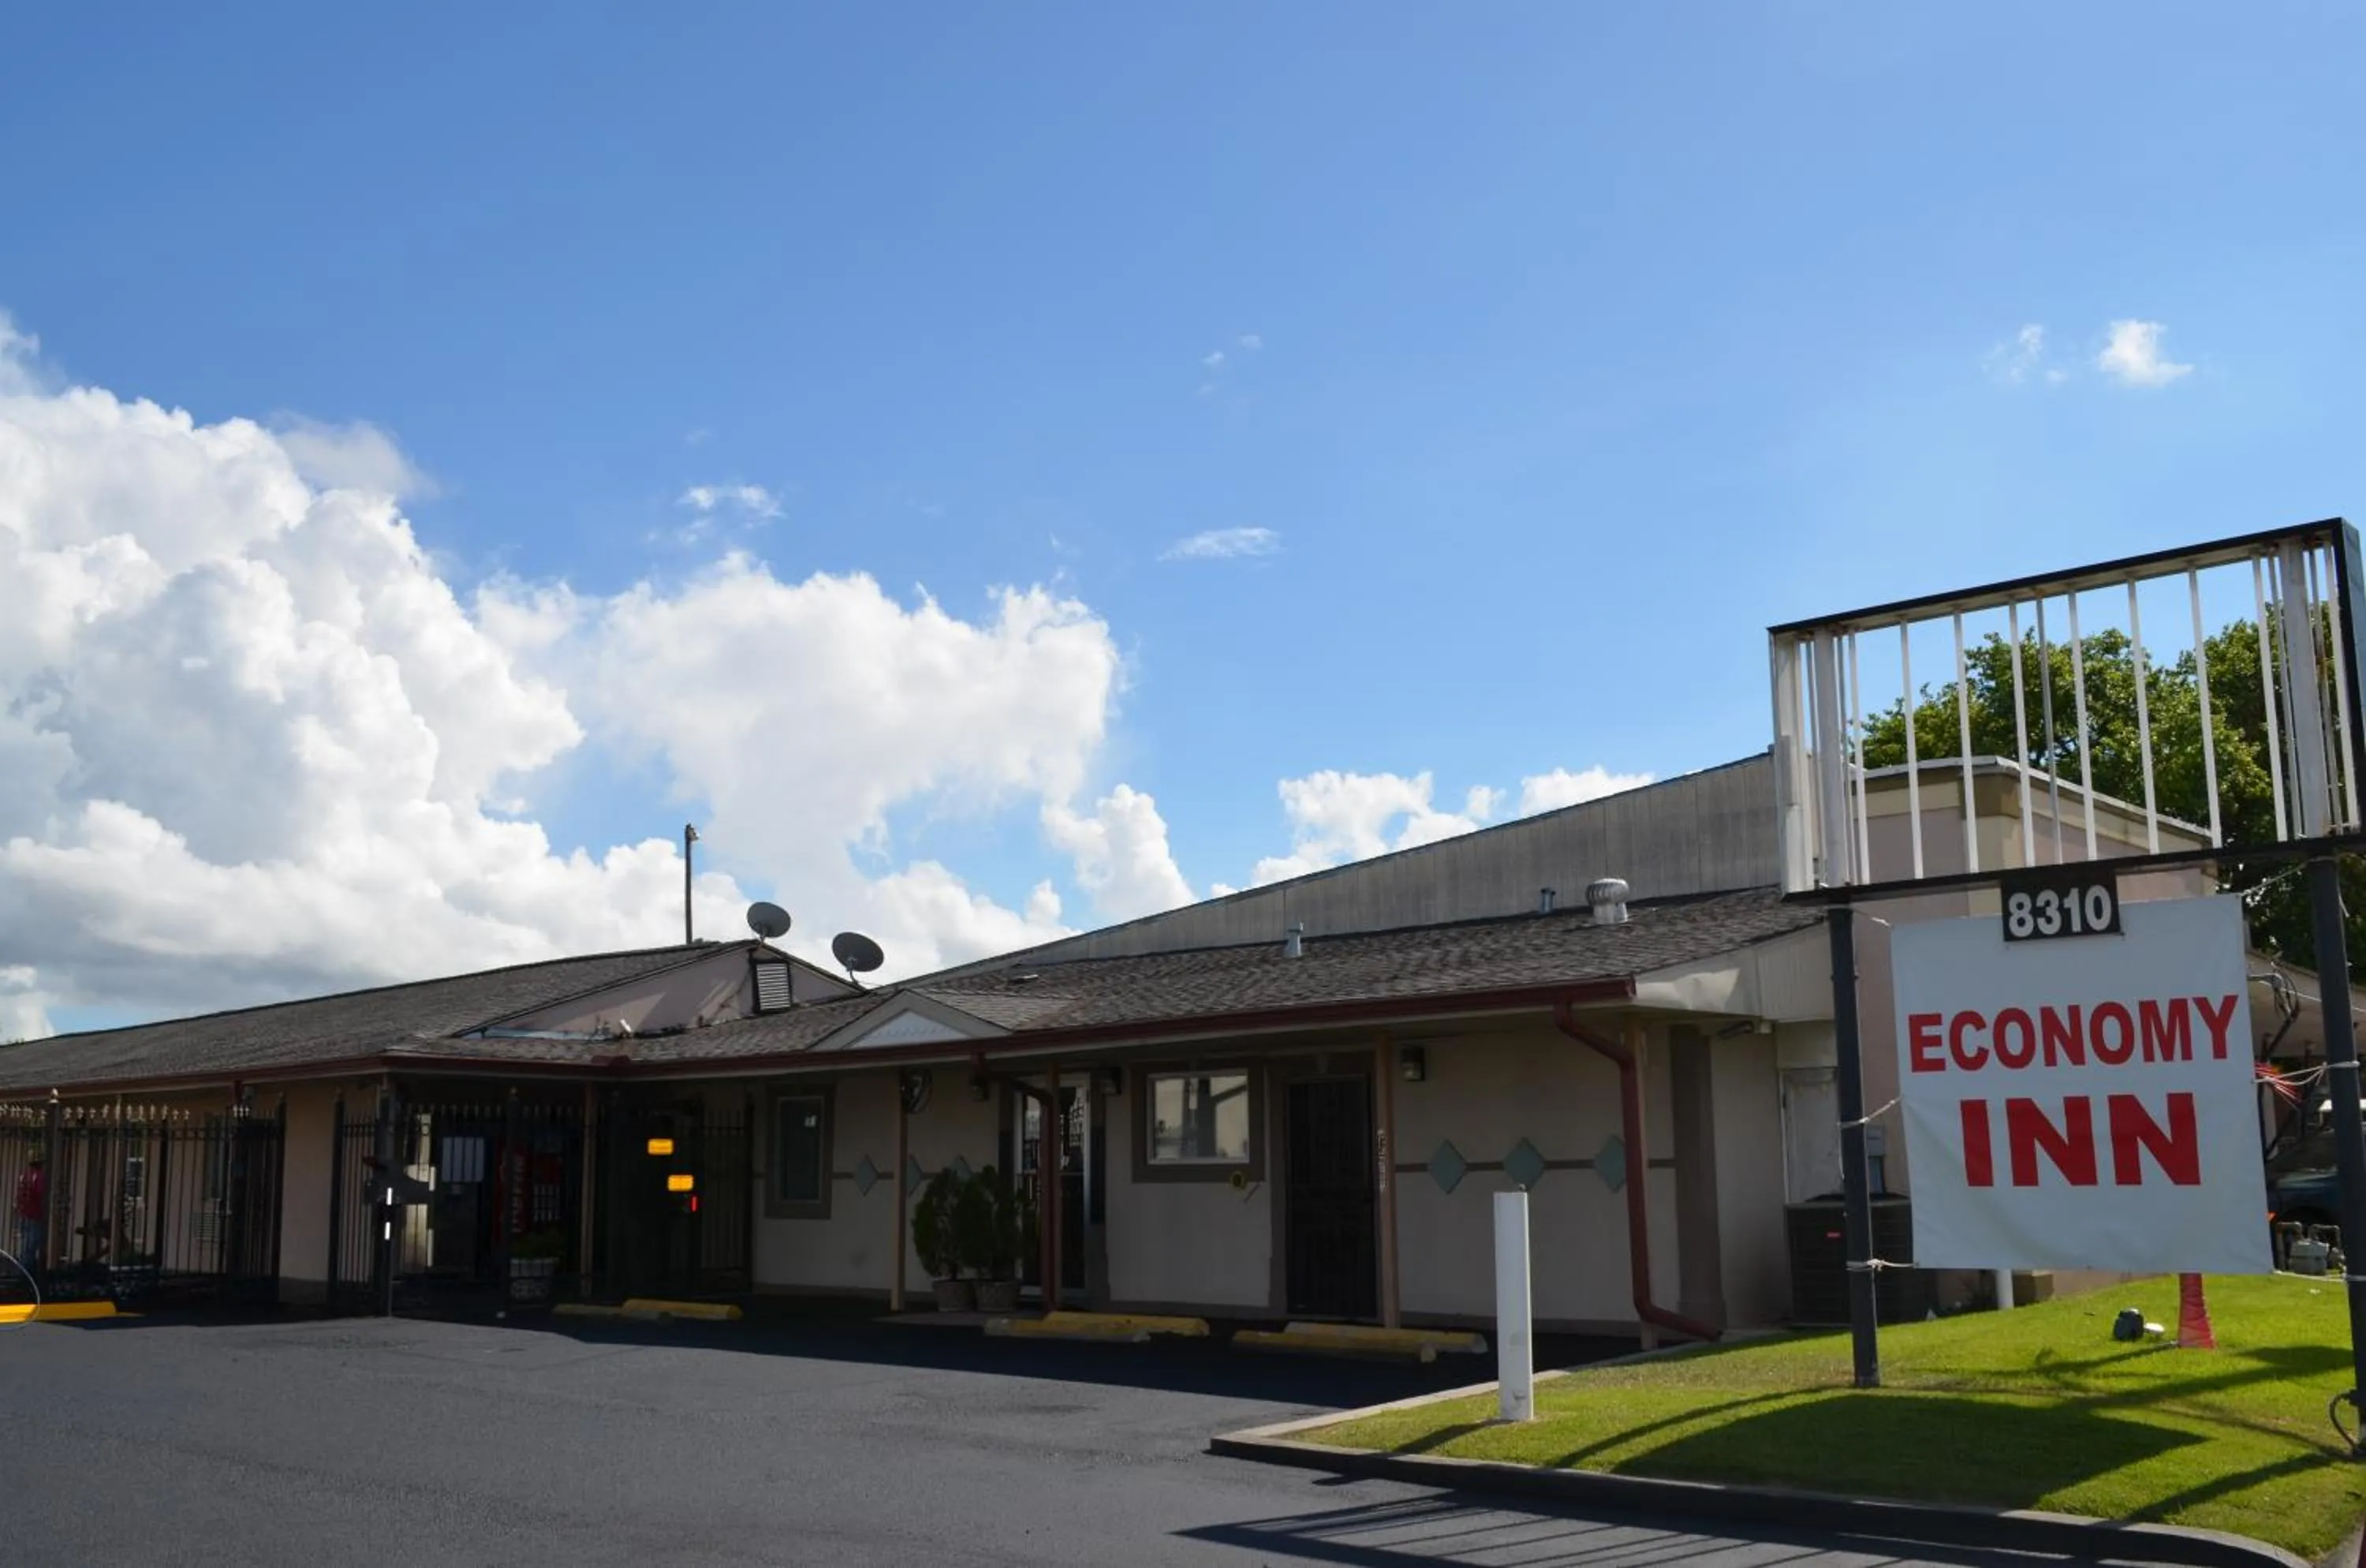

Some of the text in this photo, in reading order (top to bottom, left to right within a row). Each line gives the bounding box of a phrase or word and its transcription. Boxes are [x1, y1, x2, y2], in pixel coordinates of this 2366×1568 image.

[2007, 884, 2113, 938] 8310
[1908, 995, 2238, 1073] ECONOMY
[1960, 1092, 2201, 1187] INN
